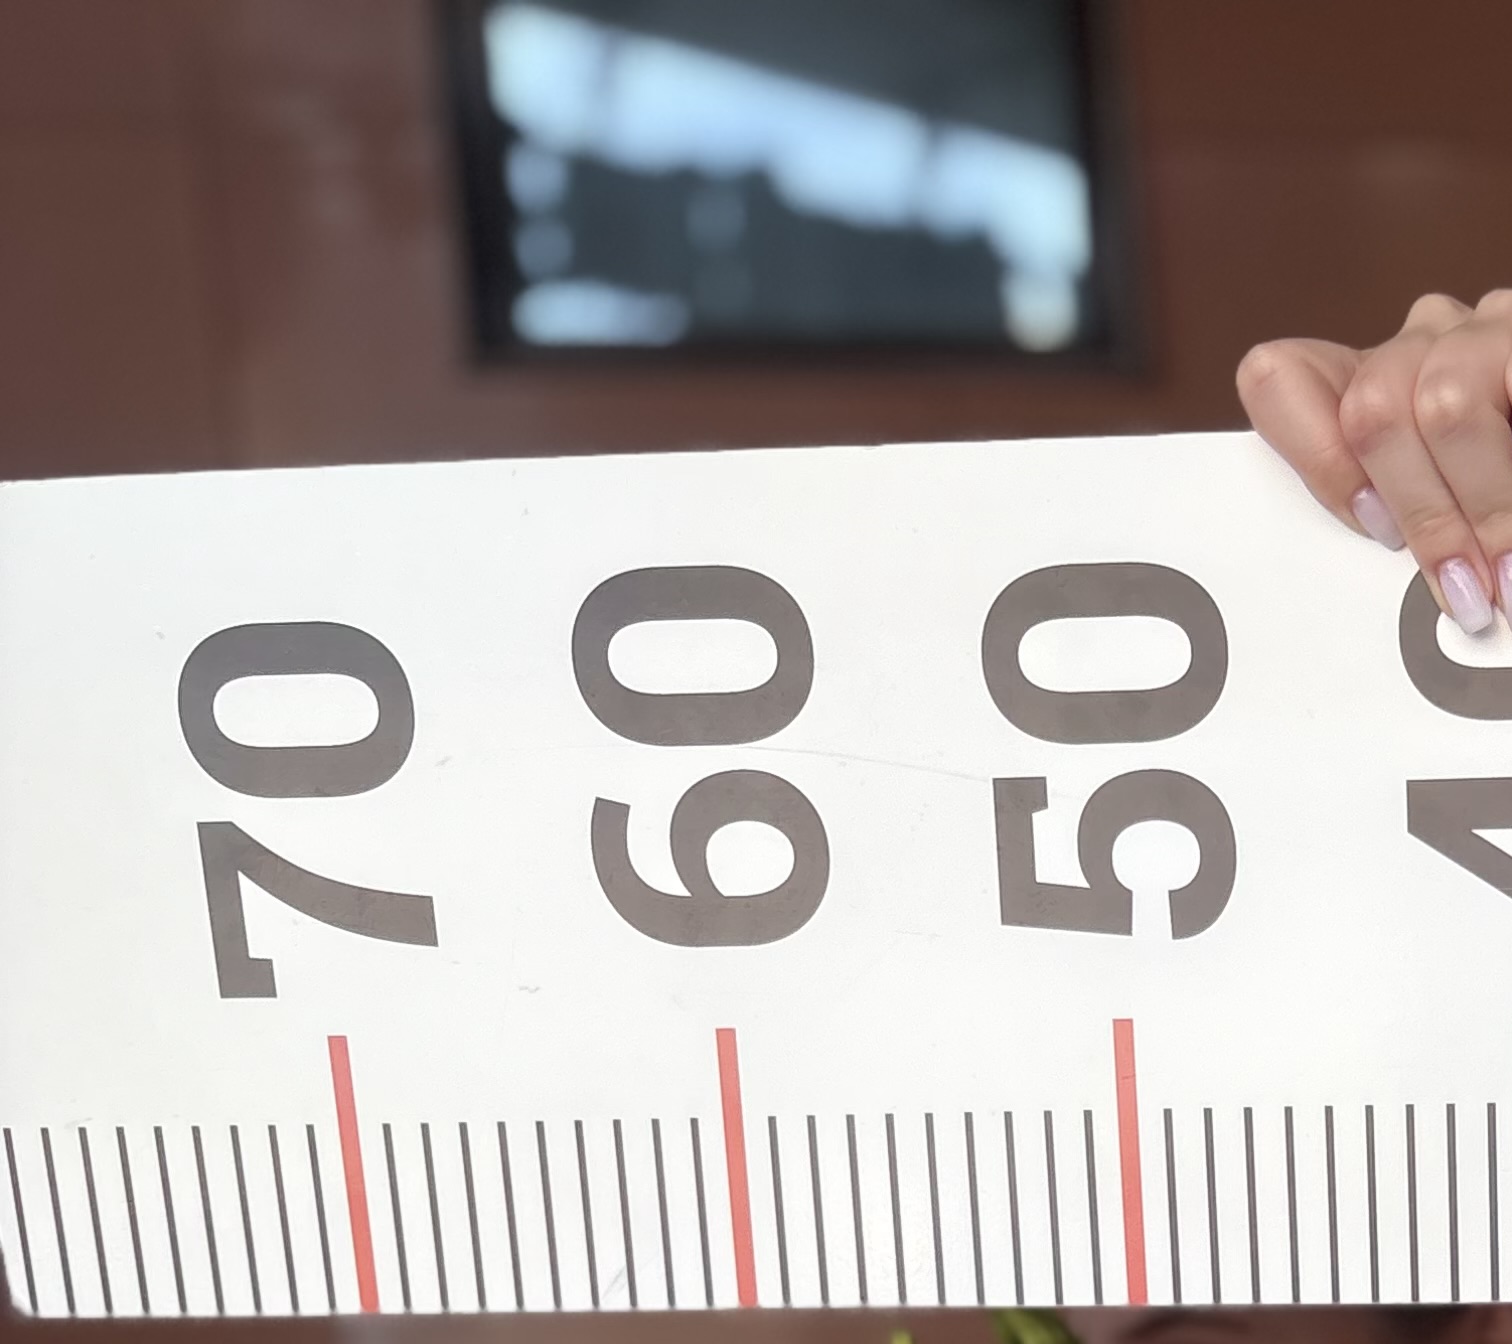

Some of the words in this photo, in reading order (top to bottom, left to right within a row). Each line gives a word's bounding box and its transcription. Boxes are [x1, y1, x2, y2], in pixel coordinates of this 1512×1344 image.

[178, 621, 437, 998] 70
[572, 565, 829, 946] 60
[982, 562, 1236, 939] 50
